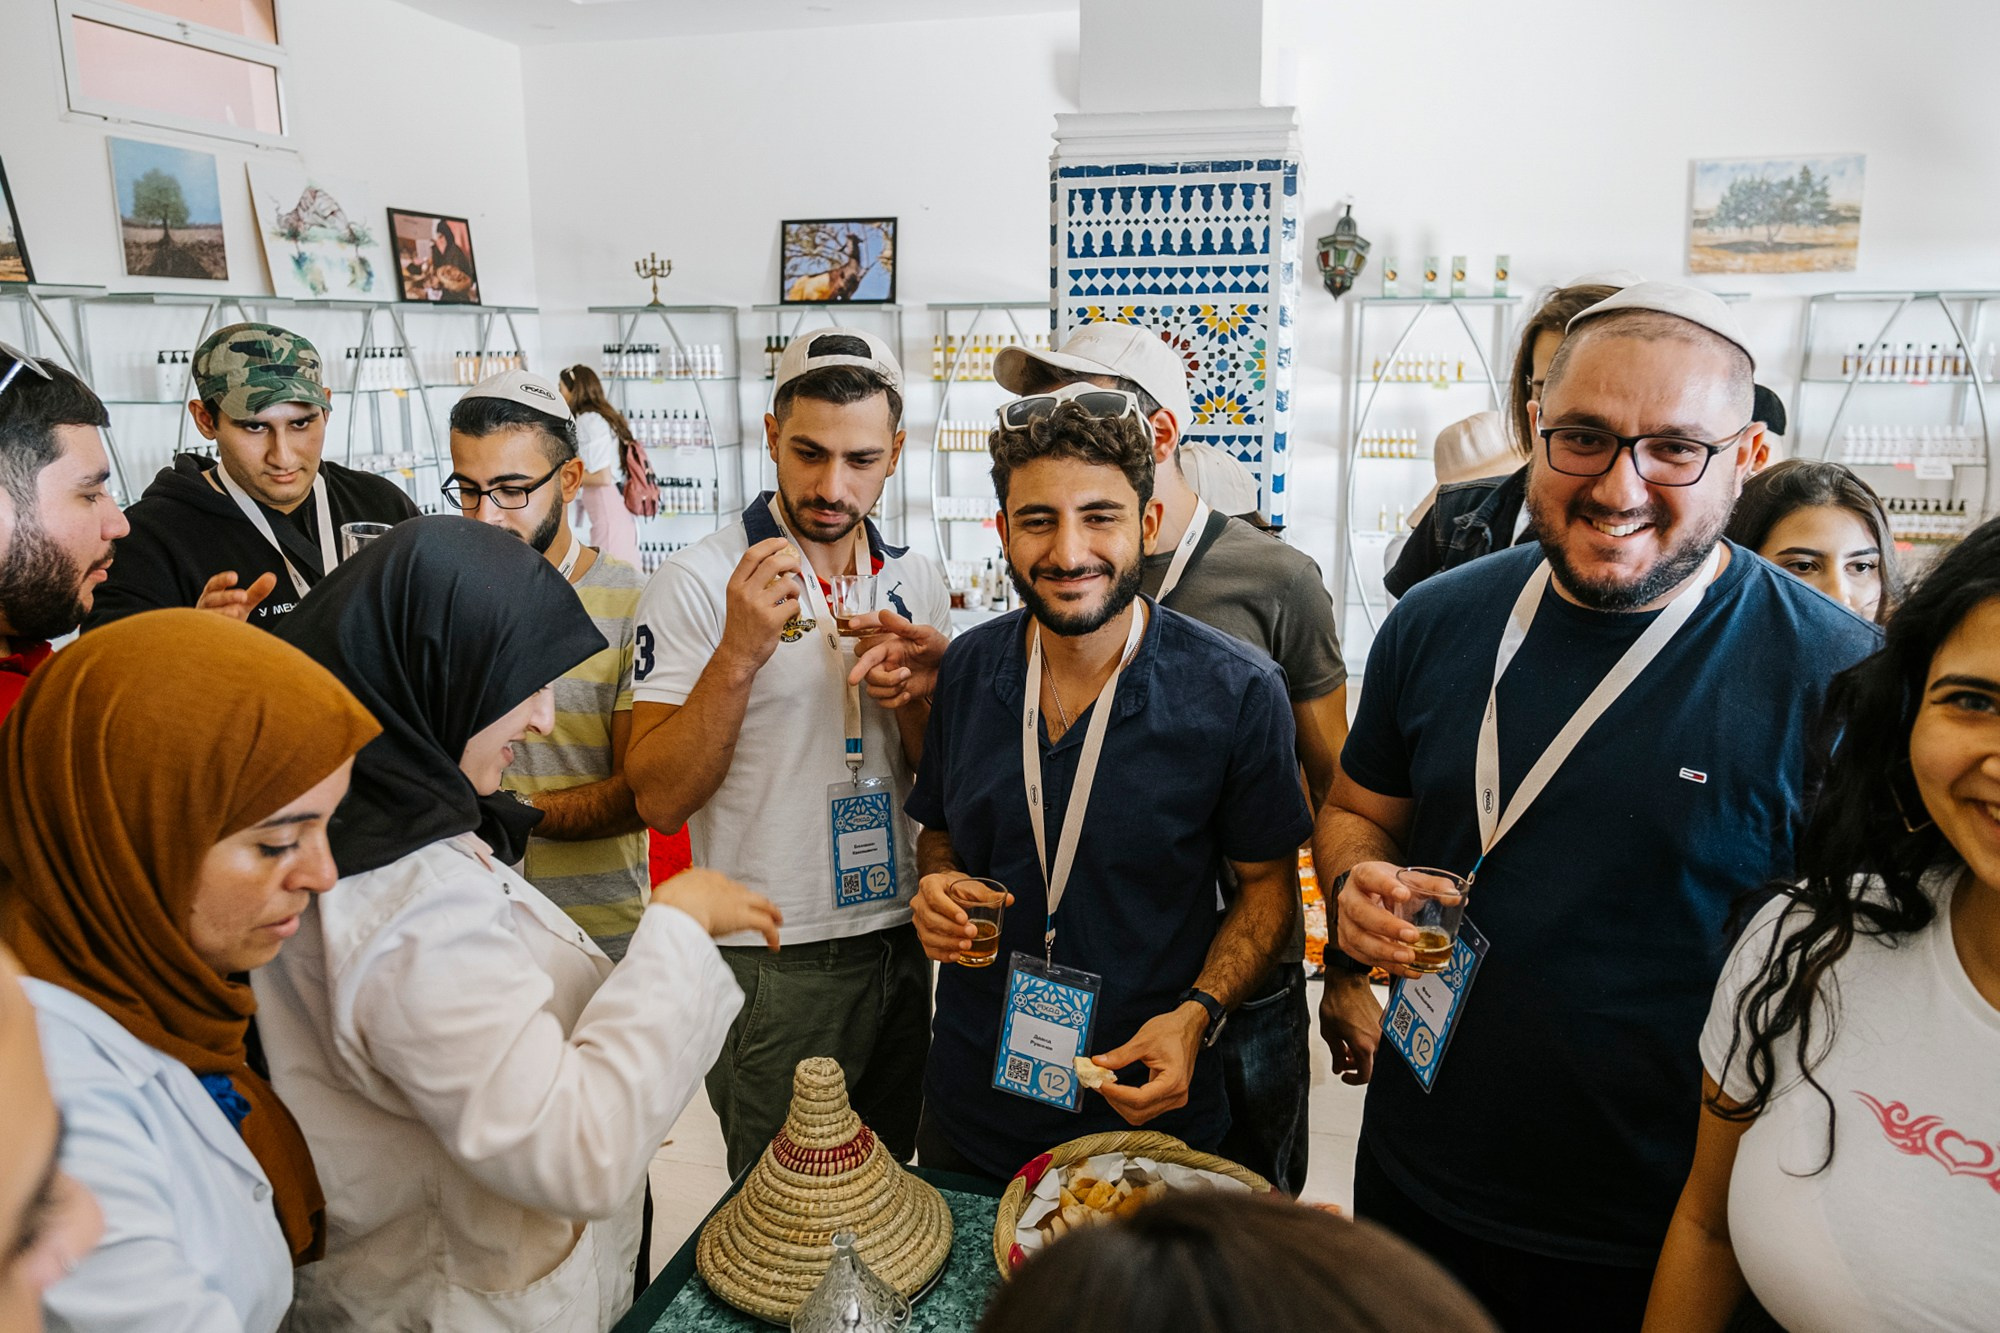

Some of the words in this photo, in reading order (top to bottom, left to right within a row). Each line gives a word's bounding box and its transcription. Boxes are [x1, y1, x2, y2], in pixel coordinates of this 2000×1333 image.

[634, 624, 655, 681] 3
[870, 871, 886, 887] 12
[1416, 1032, 1431, 1061] 12
[1043, 1071, 1065, 1091] 12
